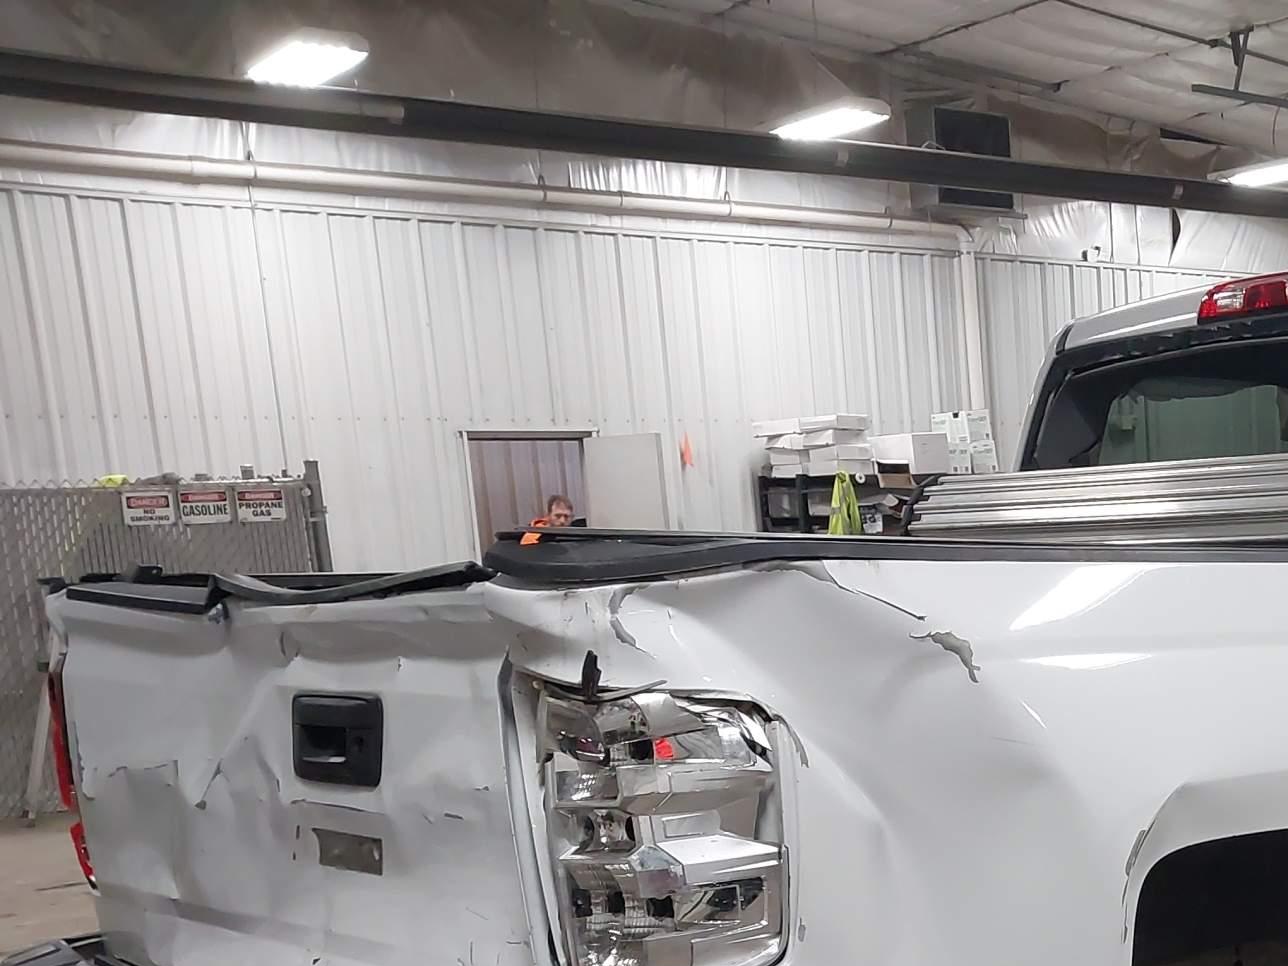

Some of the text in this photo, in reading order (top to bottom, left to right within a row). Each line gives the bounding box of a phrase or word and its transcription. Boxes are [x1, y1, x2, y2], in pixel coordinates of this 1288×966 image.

[182, 503, 229, 516] GASOLINE
[238, 501, 284, 510] PROPANE
[252, 509, 272, 517] GAS
[130, 514, 170, 522] SMOKING
